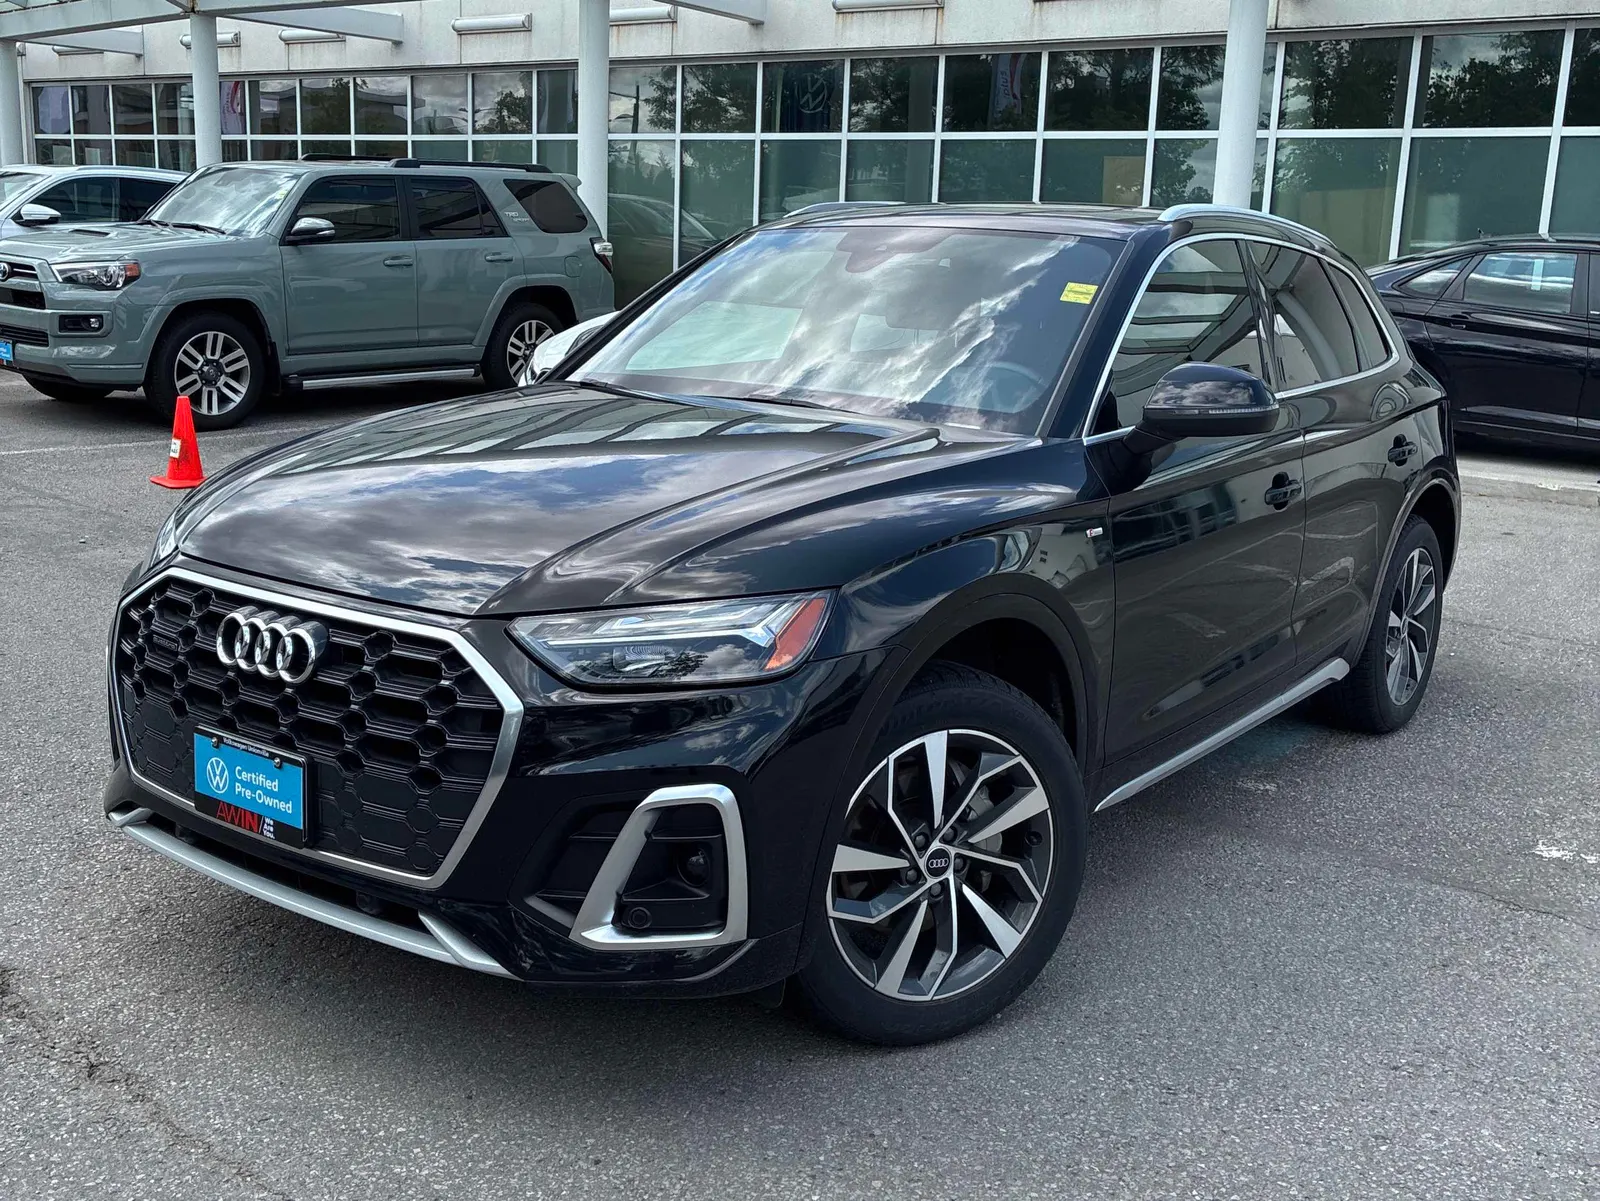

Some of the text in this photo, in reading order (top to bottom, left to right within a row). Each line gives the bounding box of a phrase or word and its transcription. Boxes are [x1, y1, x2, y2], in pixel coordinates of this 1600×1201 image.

[235, 766, 279, 792] Certified
[235, 782, 293, 814] Pre-Owned
[216, 801, 259, 833] AWIN
[263, 823, 274, 832] Are
[264, 816, 274, 826] We
